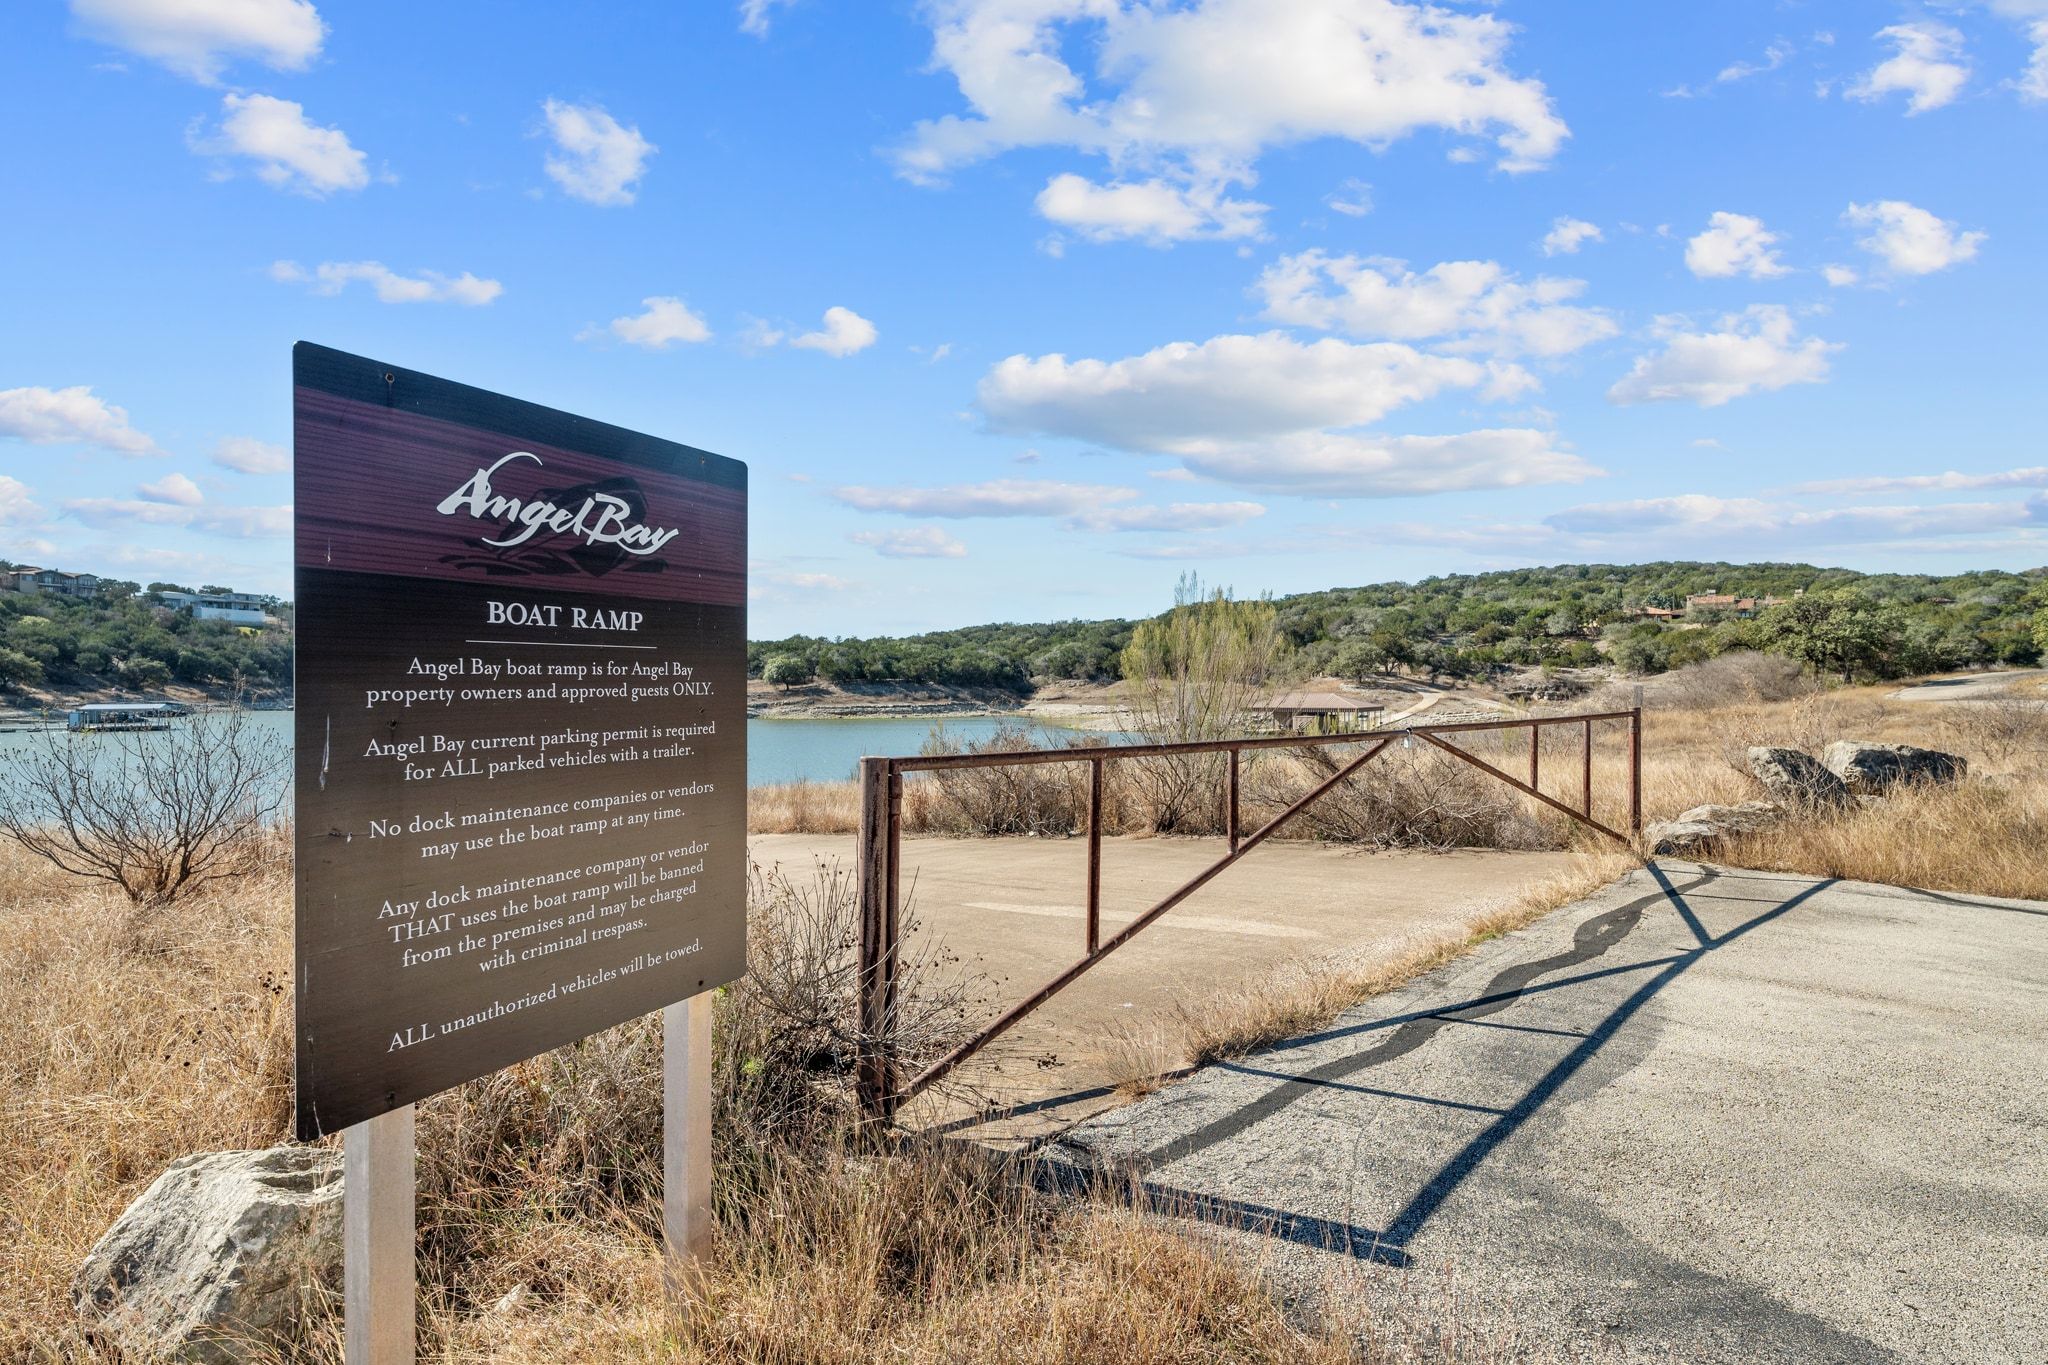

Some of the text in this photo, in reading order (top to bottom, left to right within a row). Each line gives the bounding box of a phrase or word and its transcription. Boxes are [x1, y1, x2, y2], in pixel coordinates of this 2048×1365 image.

[436, 451, 679, 555] Angel Bay
[487, 601, 643, 631] BOAT RAMP
[366, 682, 714, 708] property owners and approved guests ONLY.
[407, 657, 693, 681] Angel Bay boat ramp is for Angel Bay
[363, 721, 715, 761] Angel Bay current parking permit is required
[404, 743, 695, 780] for ALL parked vehicles with a trailer.
[369, 781, 714, 838] No dock maintenance companies or vendors
[421, 808, 685, 859] may use the boat ramp at any time.
[377, 840, 709, 919] Any dock maintenance company or vendor
[388, 859, 703, 943] THAT uses the boat ramp will be banned
[402, 880, 696, 967] from the premises and may be charged
[479, 919, 647, 972] with criminal trespass.
[387, 938, 703, 1053] ALL unauthorized vehicles will be towed.
